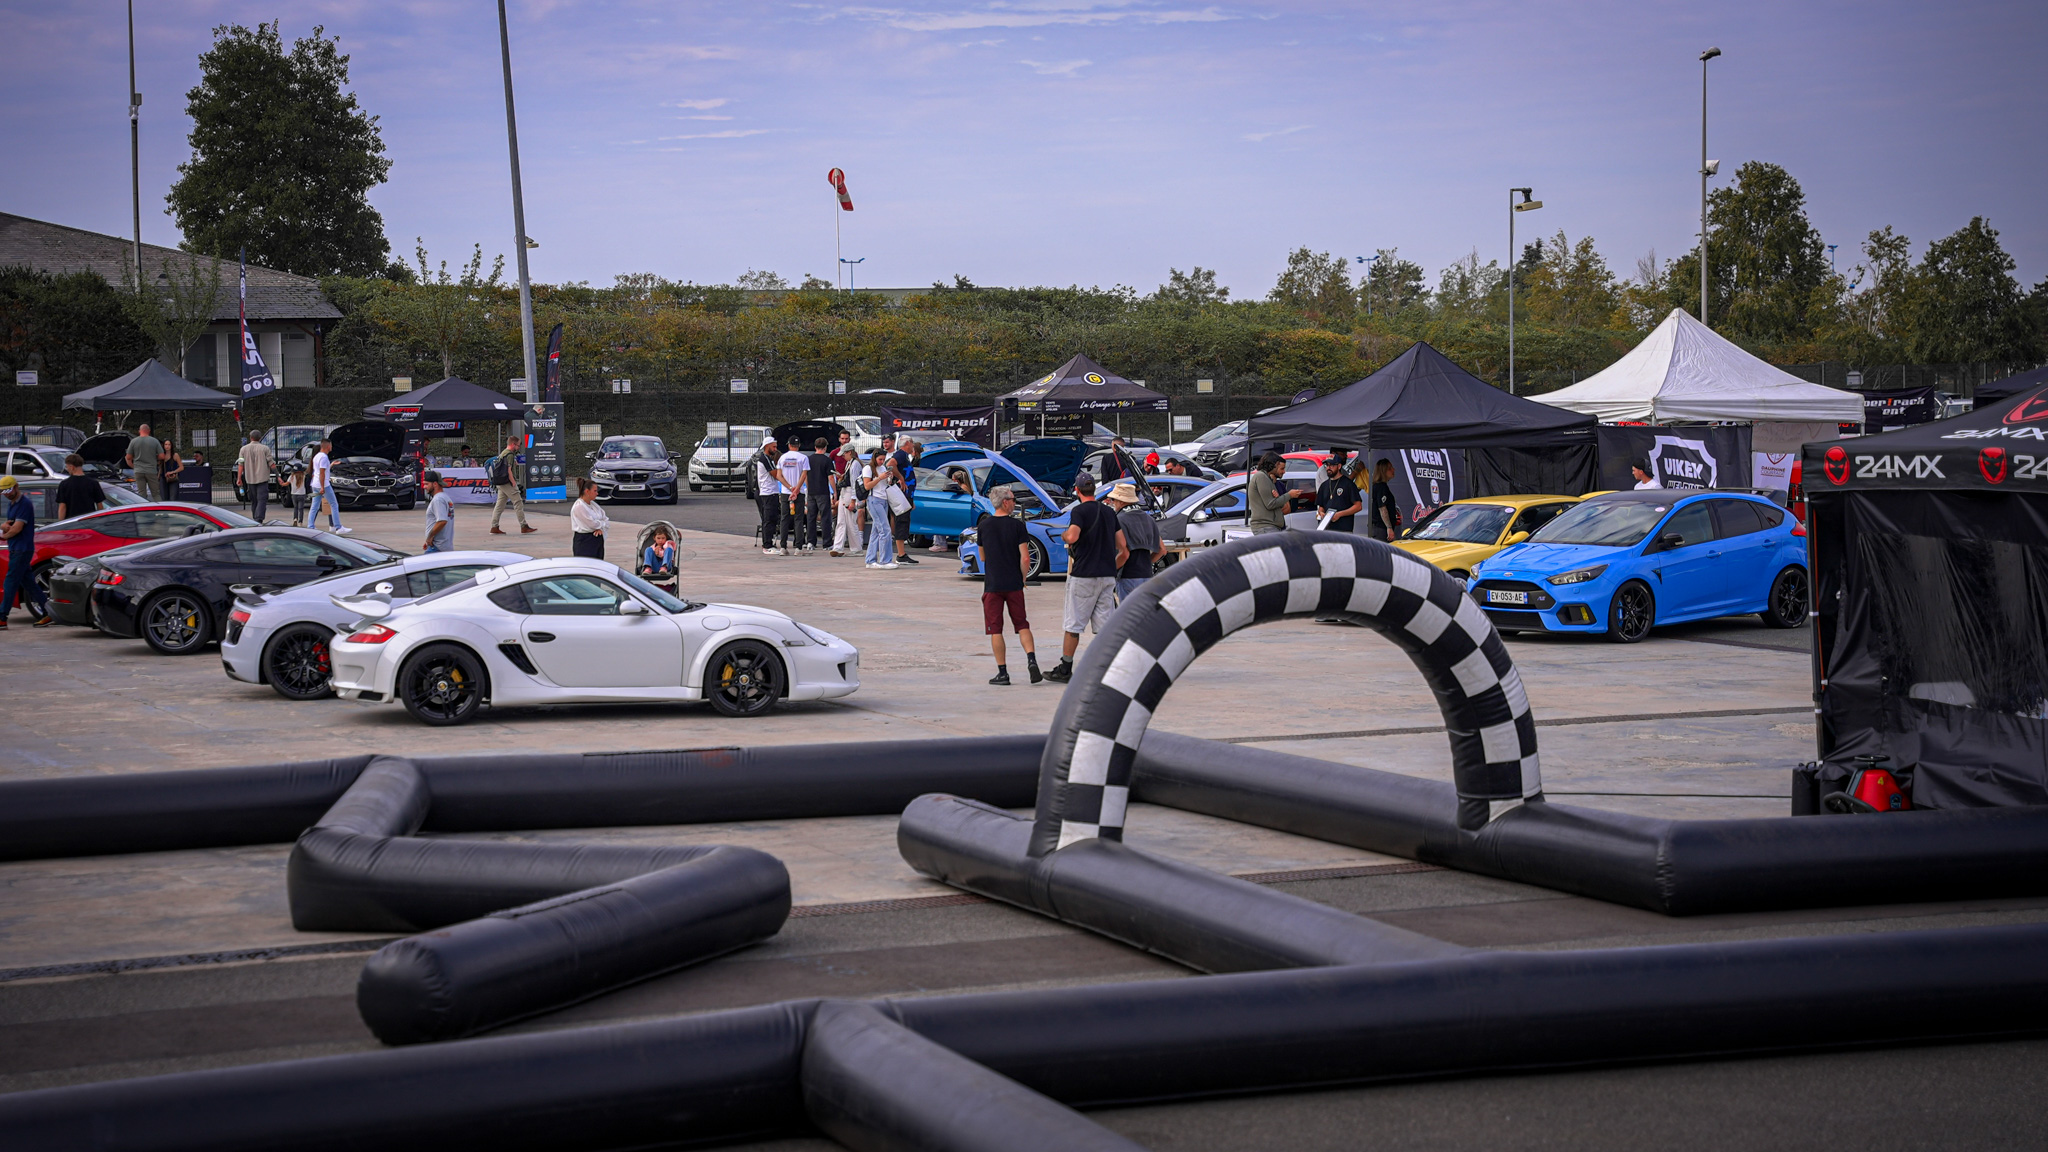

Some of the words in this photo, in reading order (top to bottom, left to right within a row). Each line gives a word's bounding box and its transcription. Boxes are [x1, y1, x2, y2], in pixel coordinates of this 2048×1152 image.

[893, 418, 989, 429] SuperTrack
[1855, 455, 1946, 479] 24MX
[1416, 467, 1446, 479] WELDING
[443, 478, 490, 487] SHIFTE
